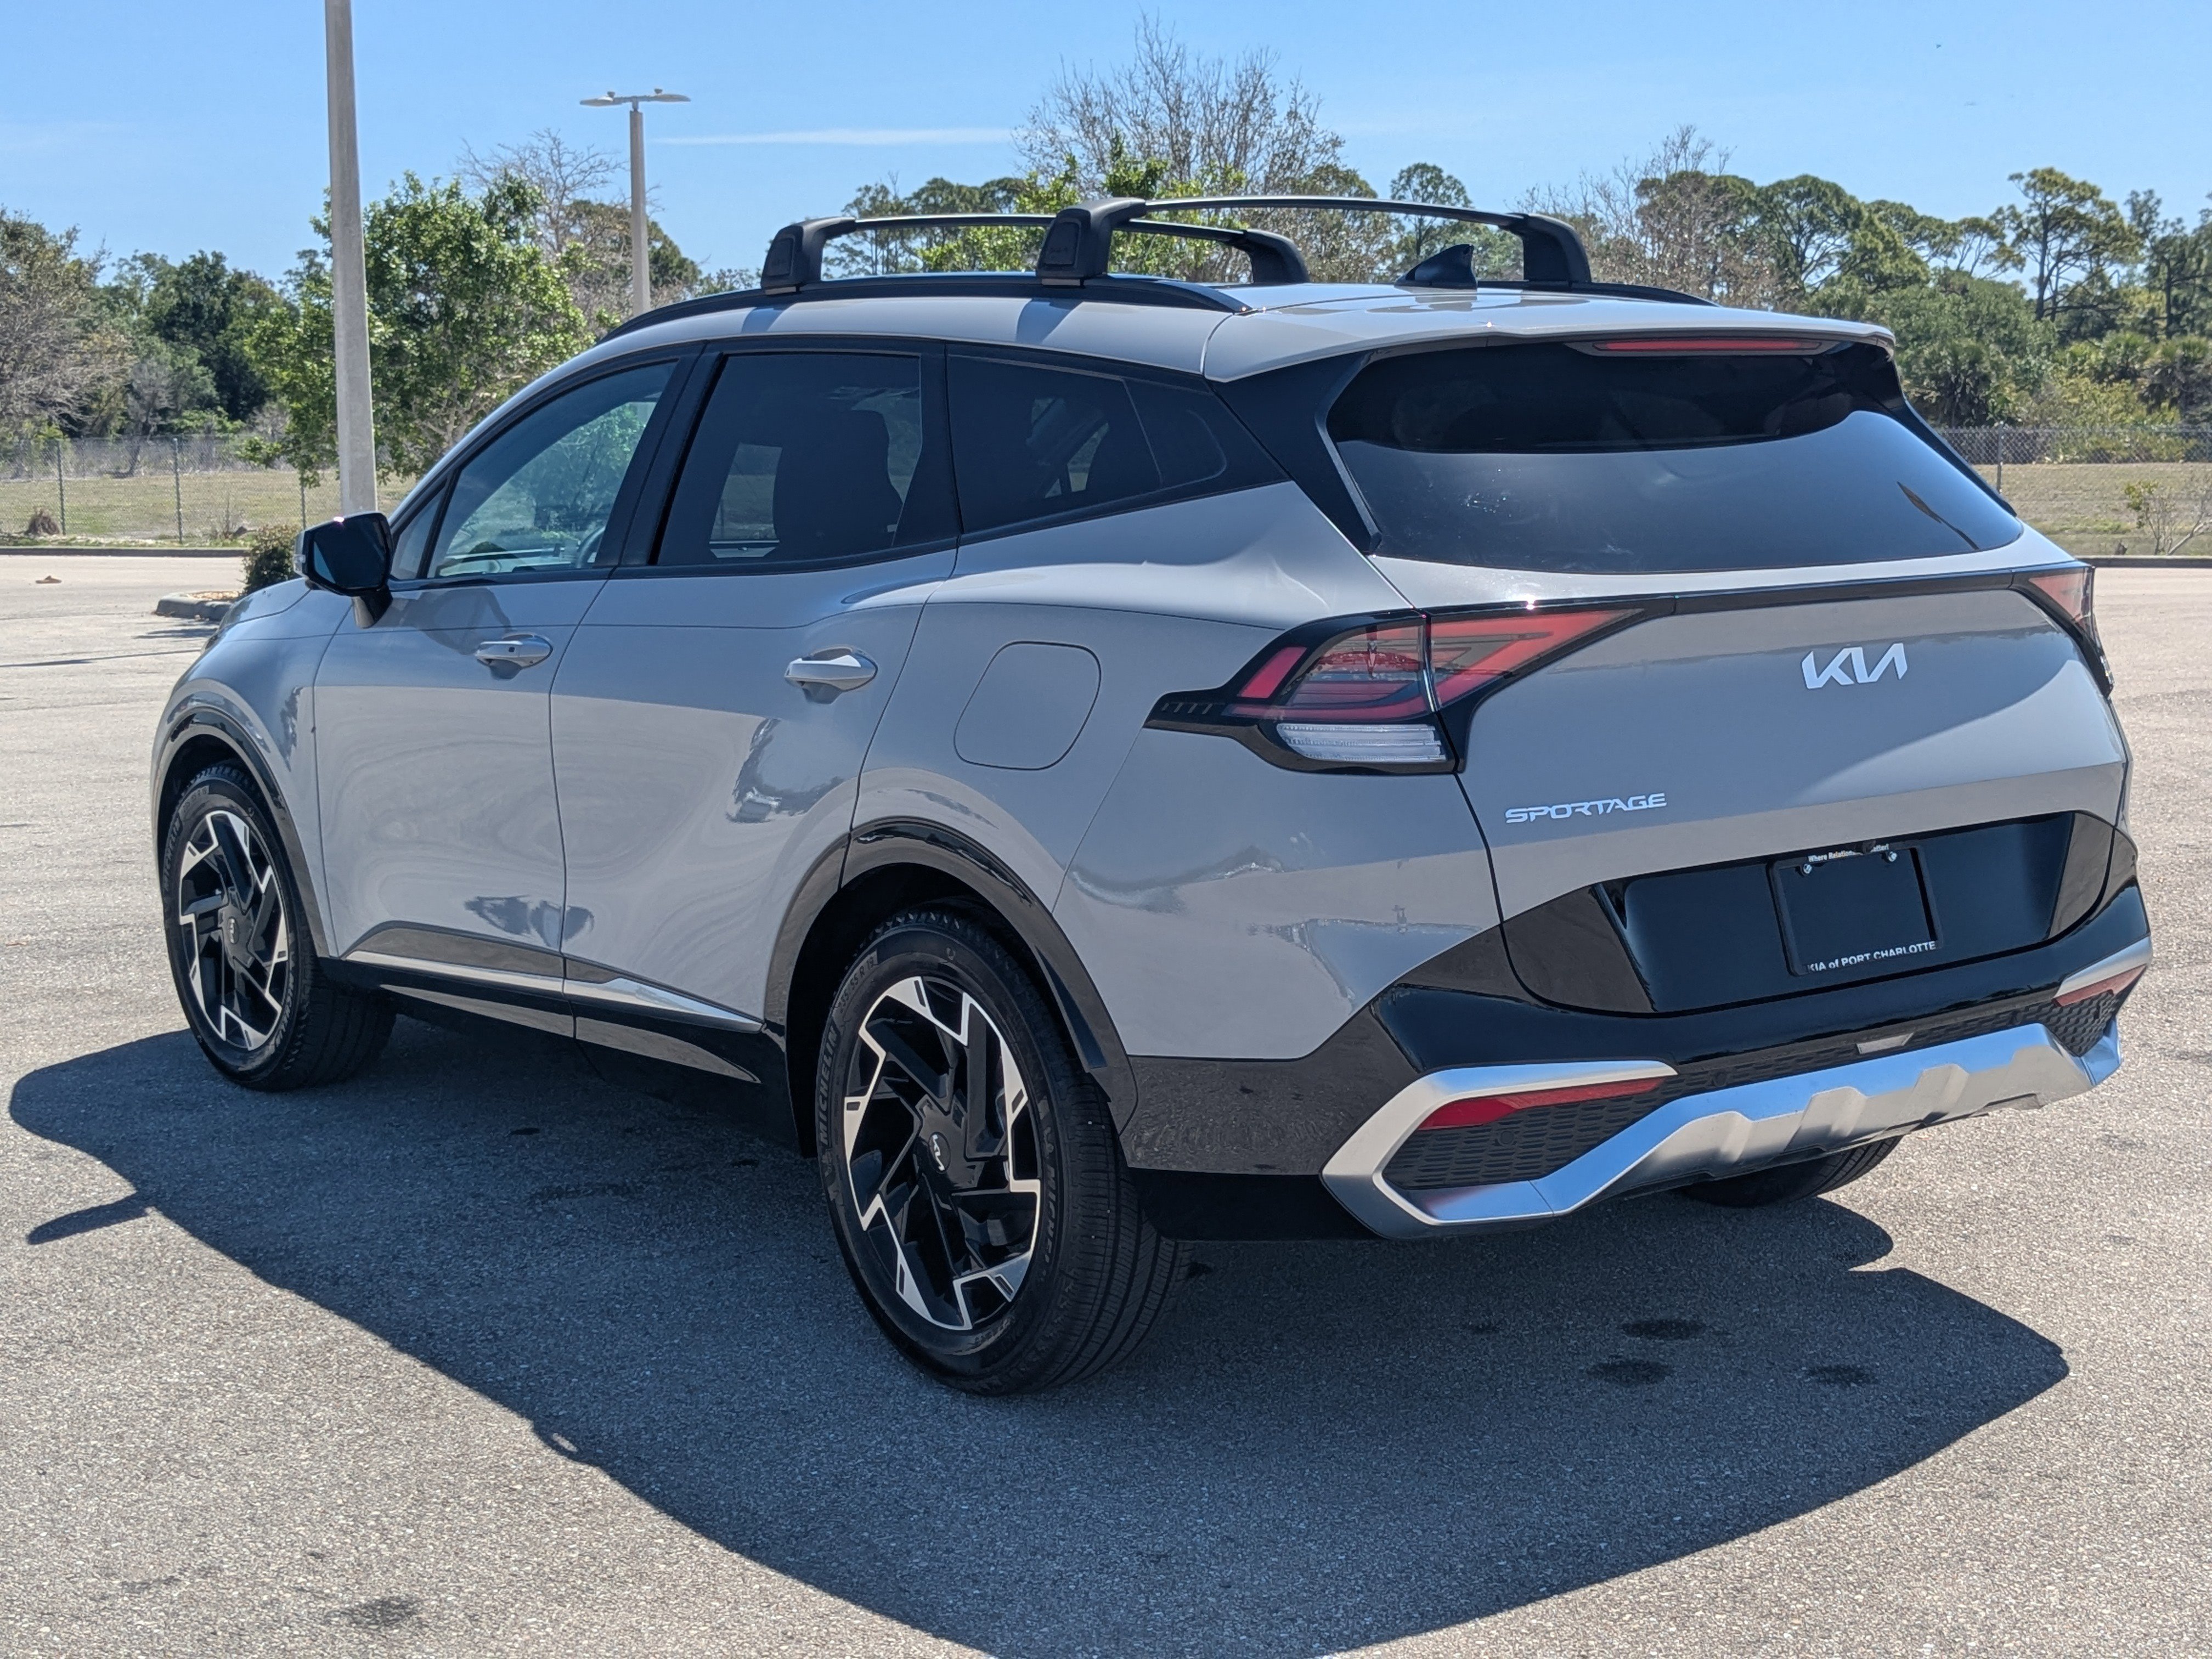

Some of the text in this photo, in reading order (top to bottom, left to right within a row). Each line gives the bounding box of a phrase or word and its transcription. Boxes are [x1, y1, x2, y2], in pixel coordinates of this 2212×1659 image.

[1802, 642, 1908, 689] KIA
[1505, 793, 1667, 823] SPORTAGE
[1808, 854, 1827, 862] Where
[1808, 941, 1937, 972] KIA of PORT CHARLOTTE
[818, 1024, 838, 1146] MICHELIN
